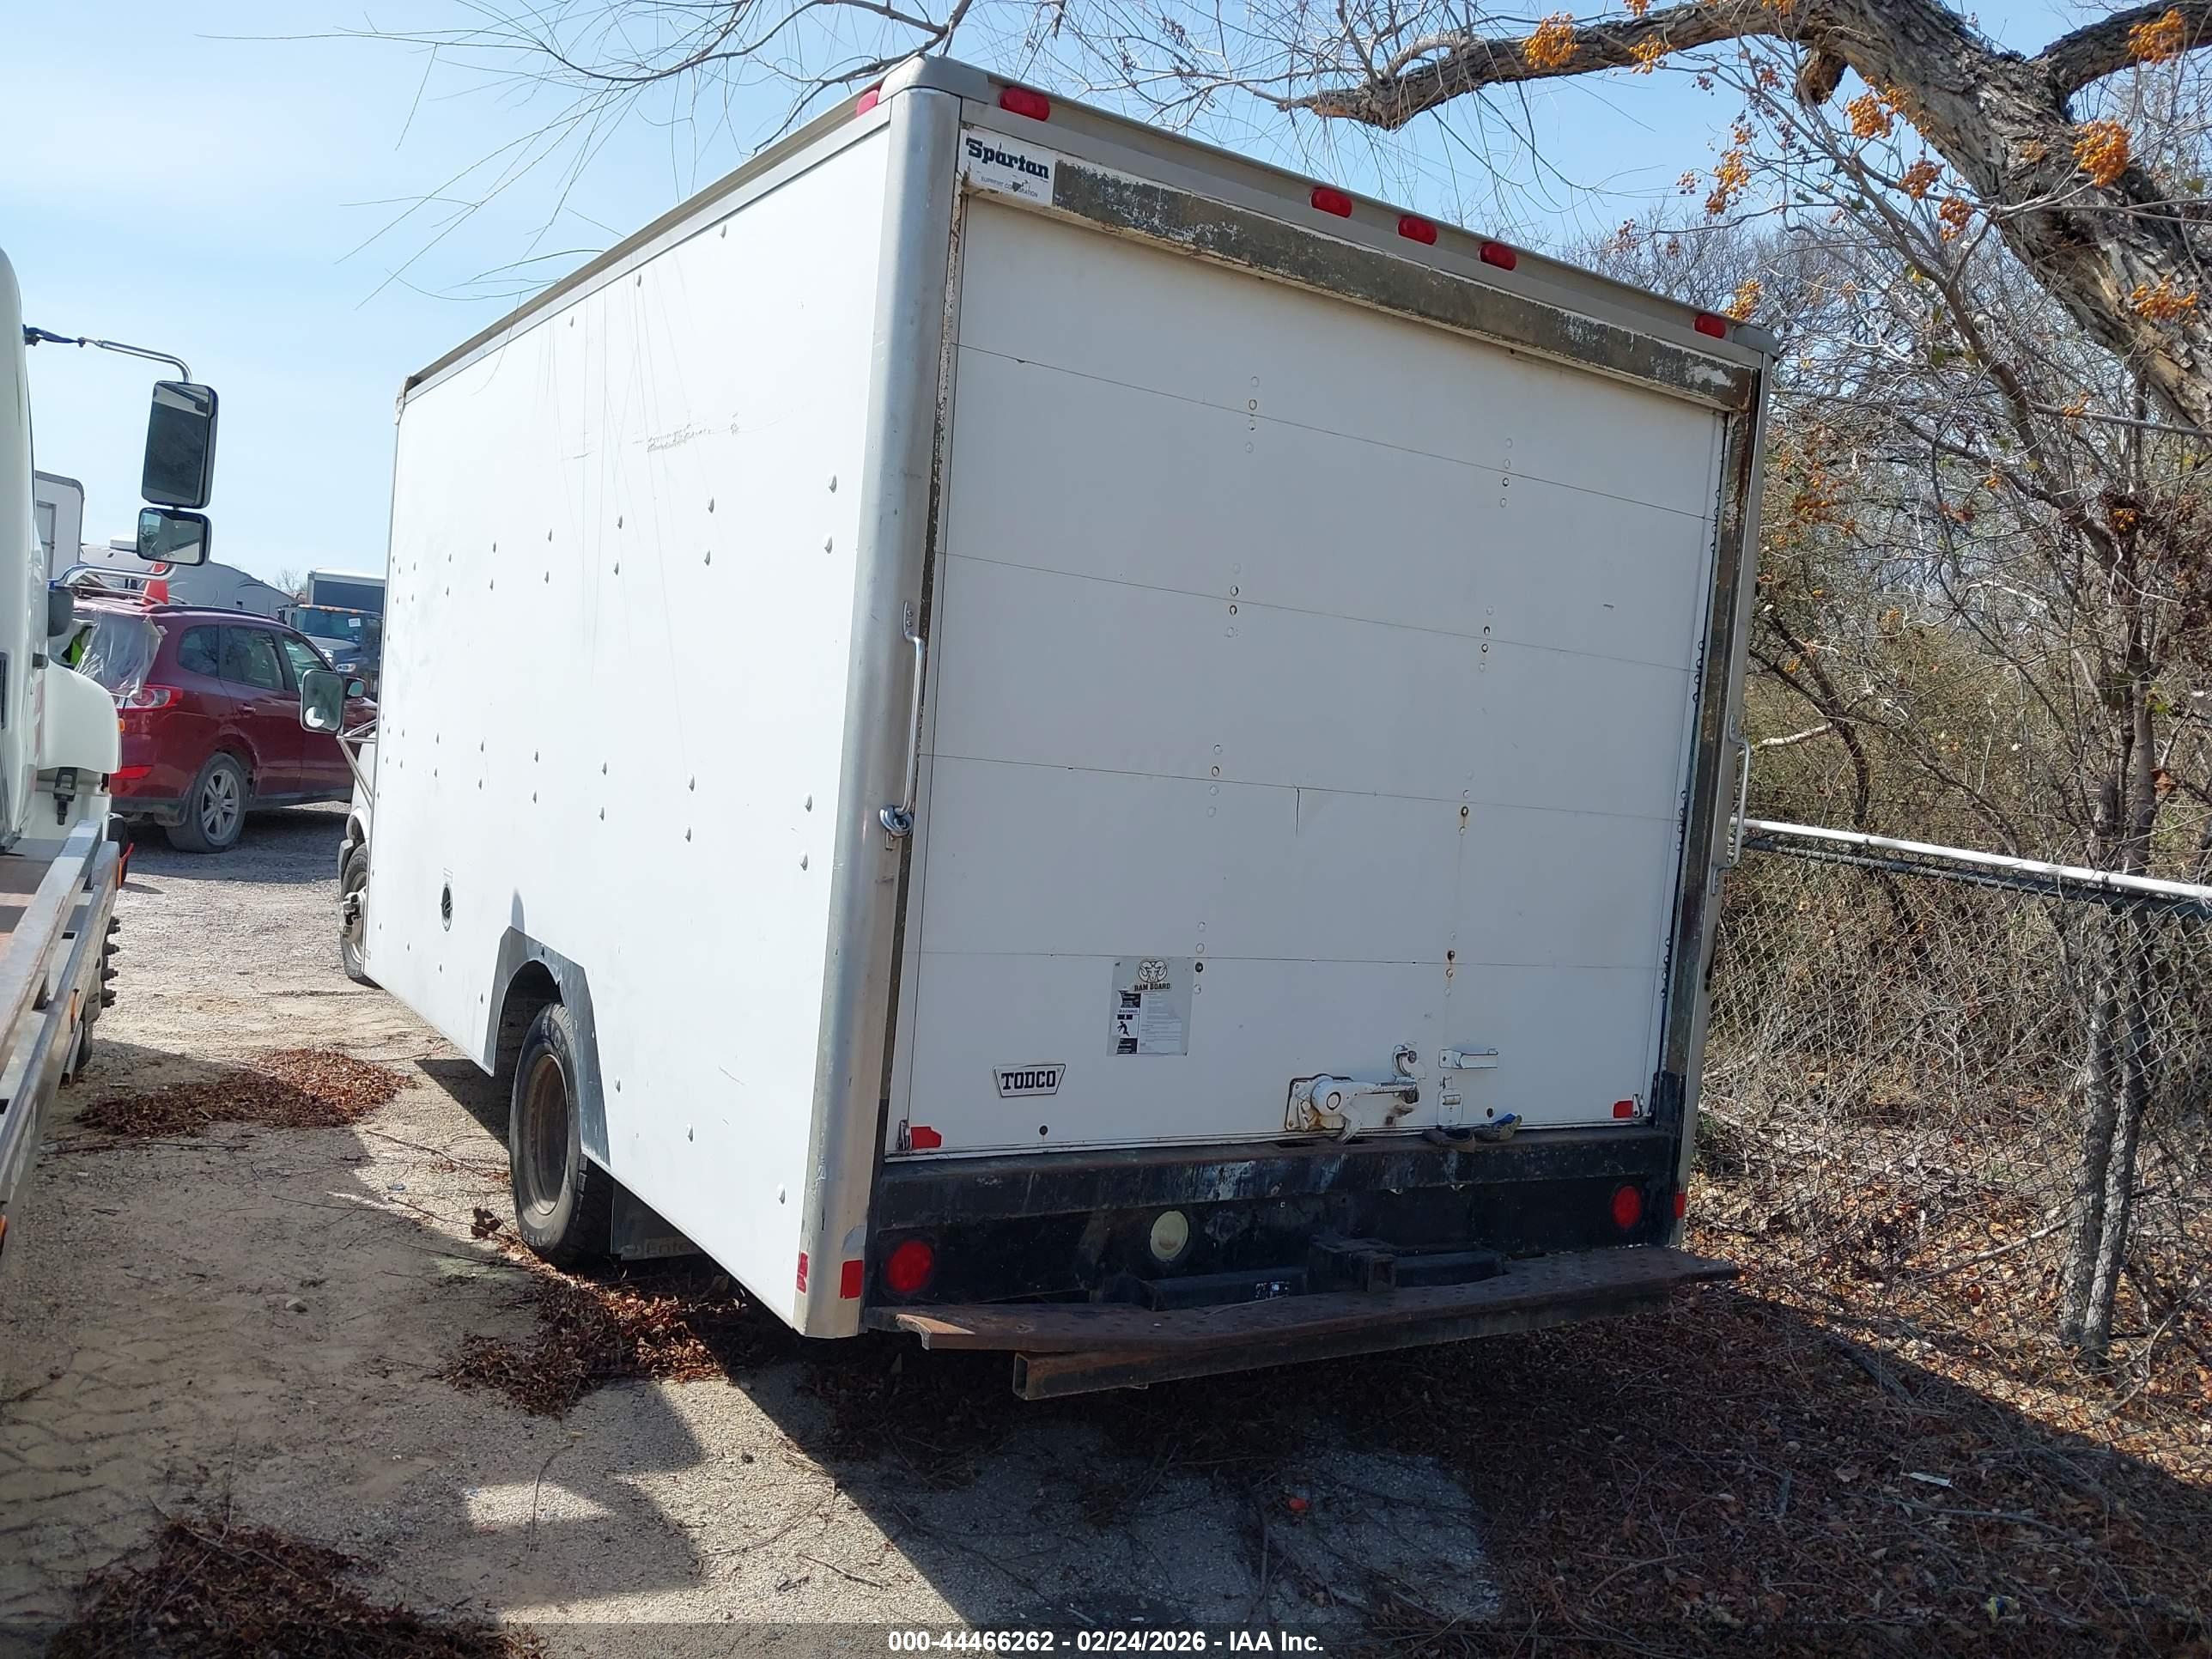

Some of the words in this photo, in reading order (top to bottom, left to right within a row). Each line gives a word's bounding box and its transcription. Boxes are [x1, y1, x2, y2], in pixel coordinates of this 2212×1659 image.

[966, 137, 1049, 179] Spartan
[1005, 183, 1038, 198] COORATION
[1001, 1070, 1056, 1090] TODCO
